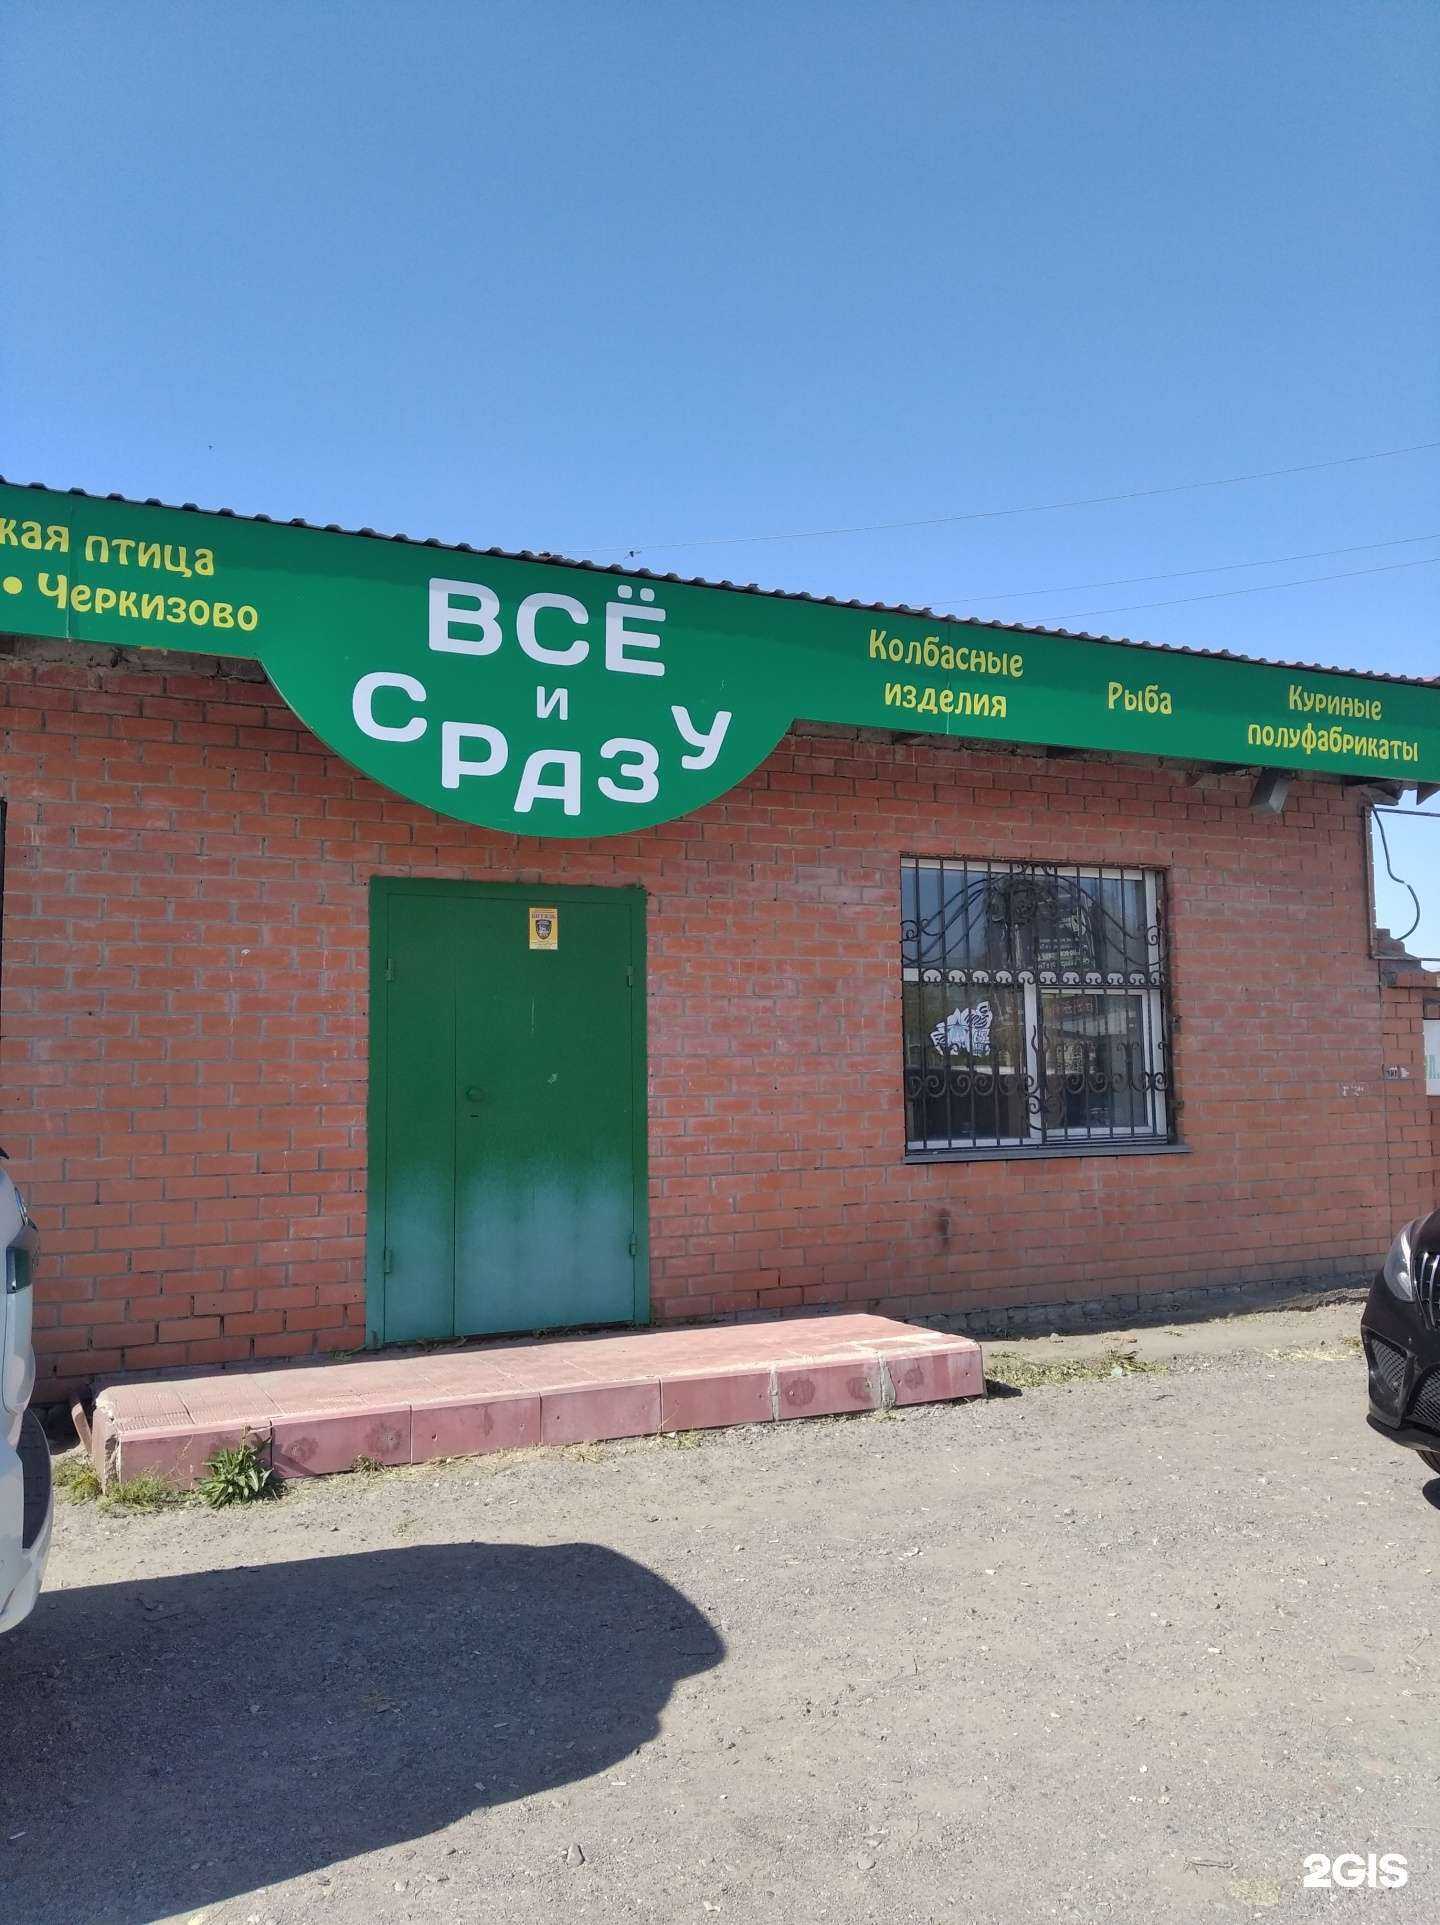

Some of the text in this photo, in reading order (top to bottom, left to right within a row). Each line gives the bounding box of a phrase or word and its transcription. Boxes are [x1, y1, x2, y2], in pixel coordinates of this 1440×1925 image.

[0, 517, 214, 577] кая птица
[38, 572, 258, 631] Черкизово
[428, 578, 666, 677] ВСЁ
[869, 629, 1023, 677] Колбасные
[884, 682, 1007, 718] изделия
[1108, 682, 1172, 714] Рыба
[1289, 685, 1382, 721] Куриные
[352, 671, 732, 816] СРАЗУ
[1247, 722, 1418, 762] полуфабрикаты
